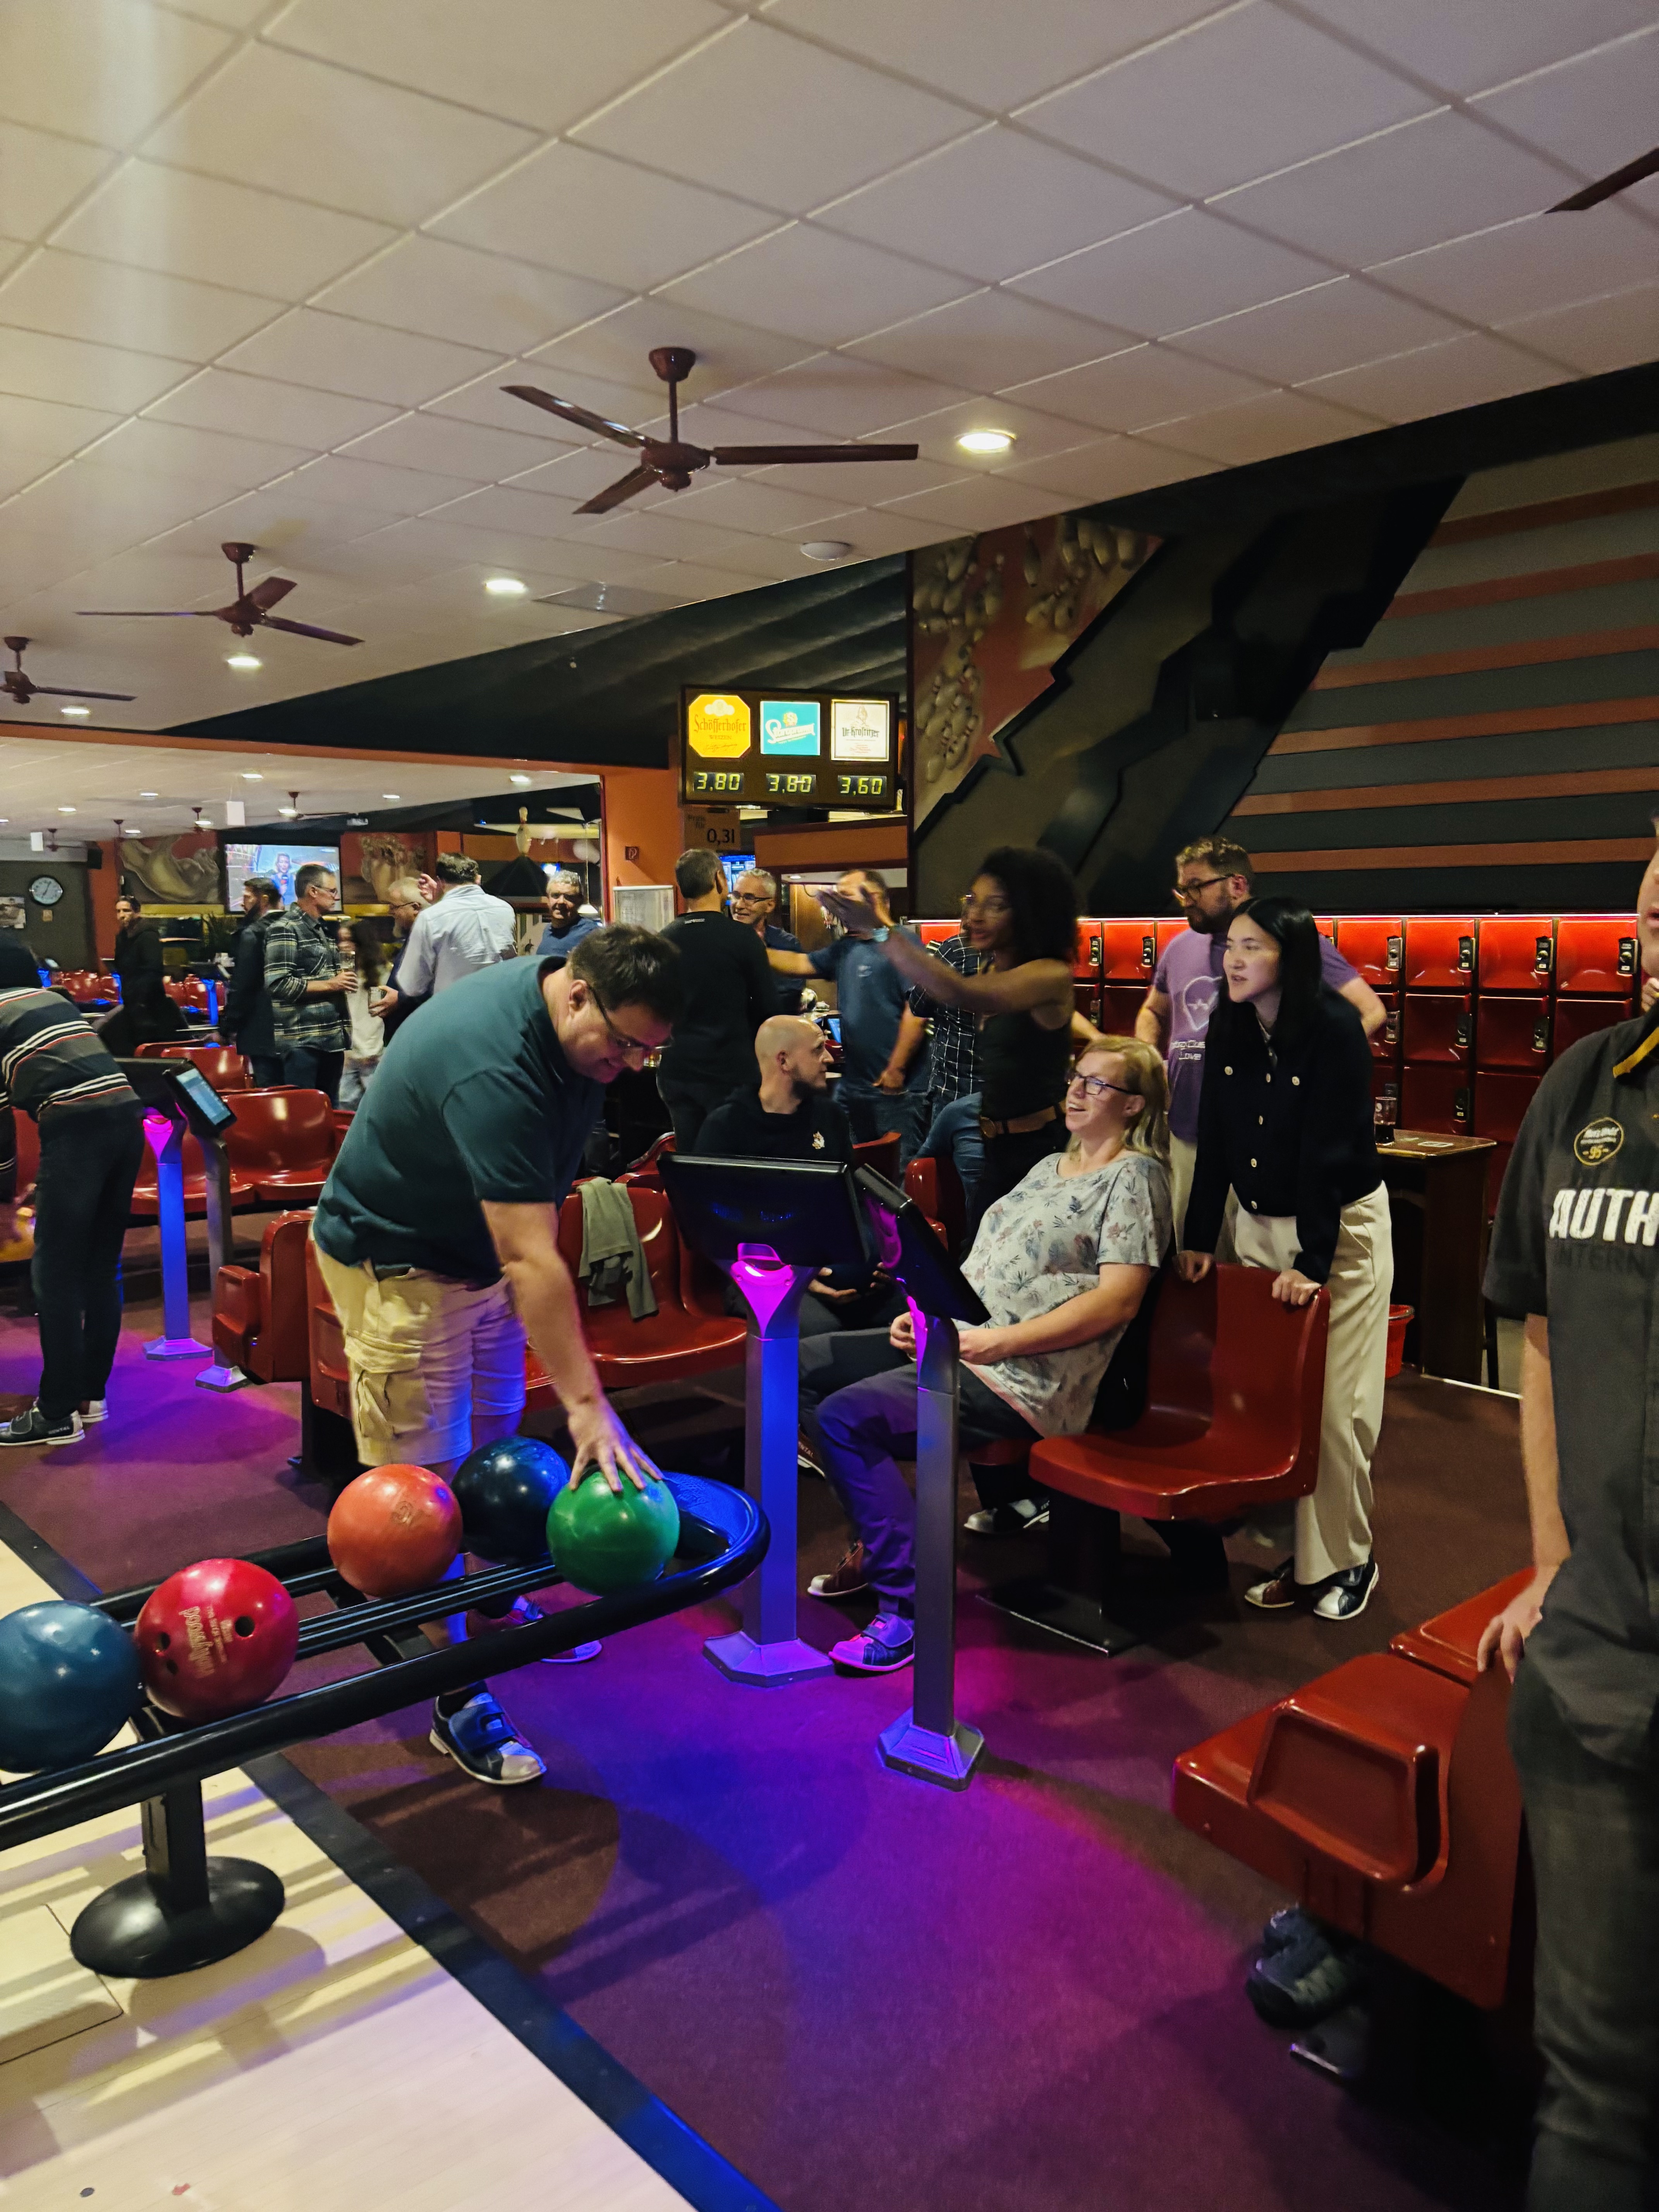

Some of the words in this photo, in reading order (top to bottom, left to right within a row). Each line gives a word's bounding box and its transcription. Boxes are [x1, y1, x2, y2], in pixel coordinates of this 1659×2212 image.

[694, 714, 747, 733] Schöfferhofer
[697, 773, 740, 792] 3,80
[840, 777, 883, 796] 3,60
[1549, 1187, 1659, 1246] AUTH
